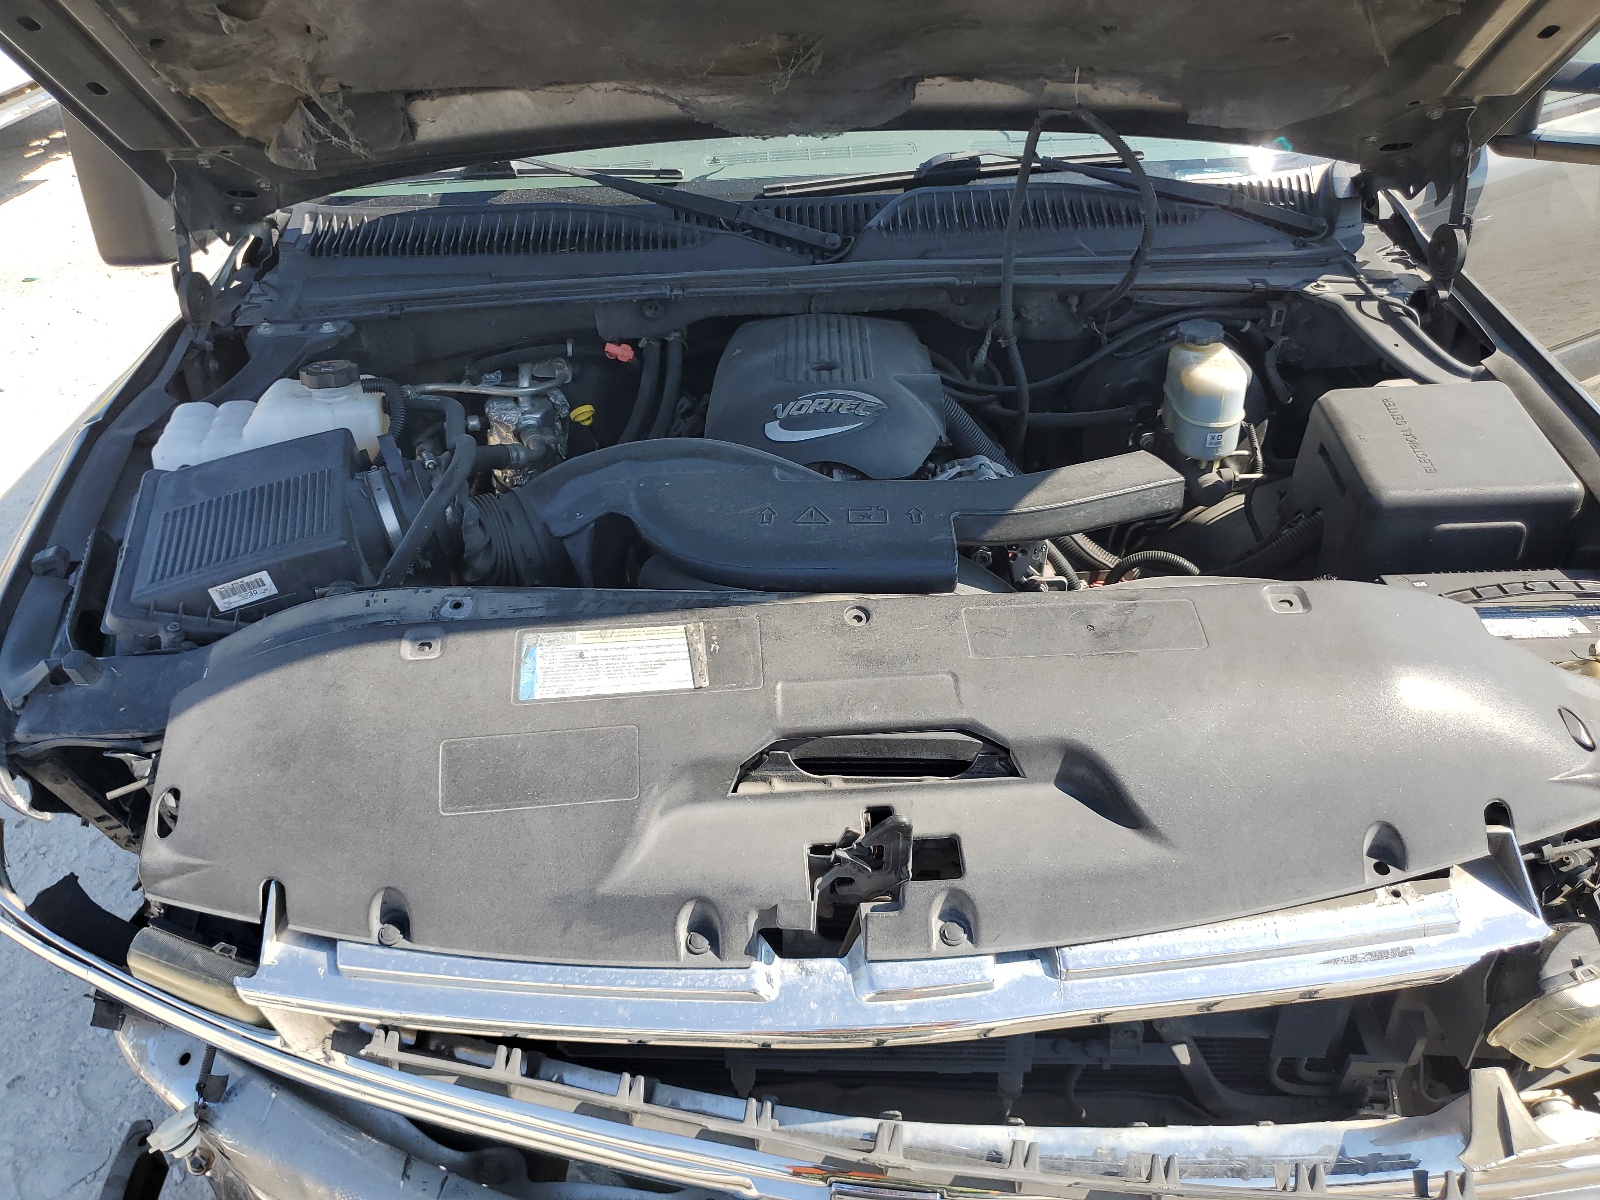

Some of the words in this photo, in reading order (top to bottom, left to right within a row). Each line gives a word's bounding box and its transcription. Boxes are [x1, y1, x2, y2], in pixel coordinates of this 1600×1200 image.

[772, 398, 879, 419] VORTEC
[1381, 397, 1407, 426] CENTER
[1400, 427, 1437, 474] ELECTRICAL
